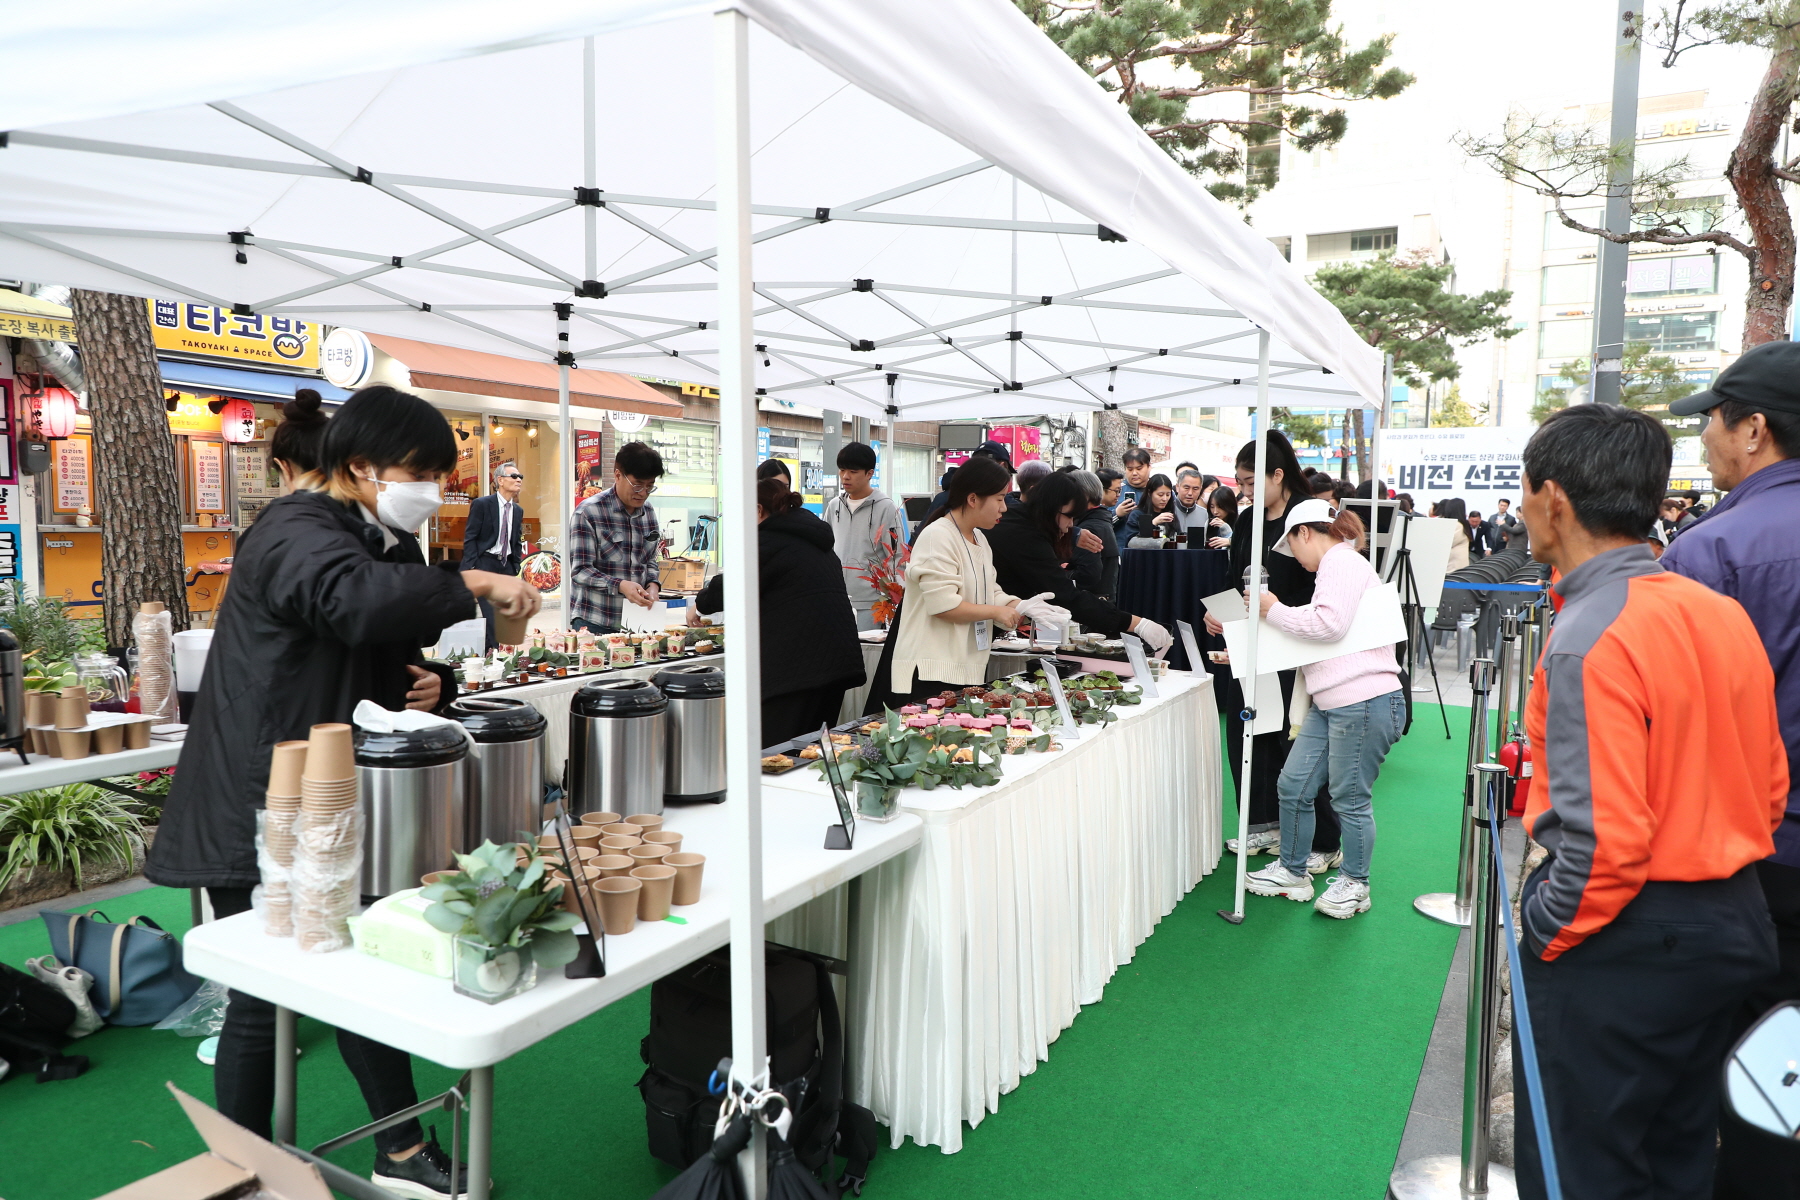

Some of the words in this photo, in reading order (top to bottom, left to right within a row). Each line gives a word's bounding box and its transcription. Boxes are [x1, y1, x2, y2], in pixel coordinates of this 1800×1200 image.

[1633, 268, 1667, 289] 전용
[1674, 266, 1709, 288] 헬스
[181, 339, 230, 352] TAKOYAKI
[243, 348, 273, 358] SPACE
[1398, 465, 1453, 490] 비전
[1464, 465, 1521, 490] 선포
